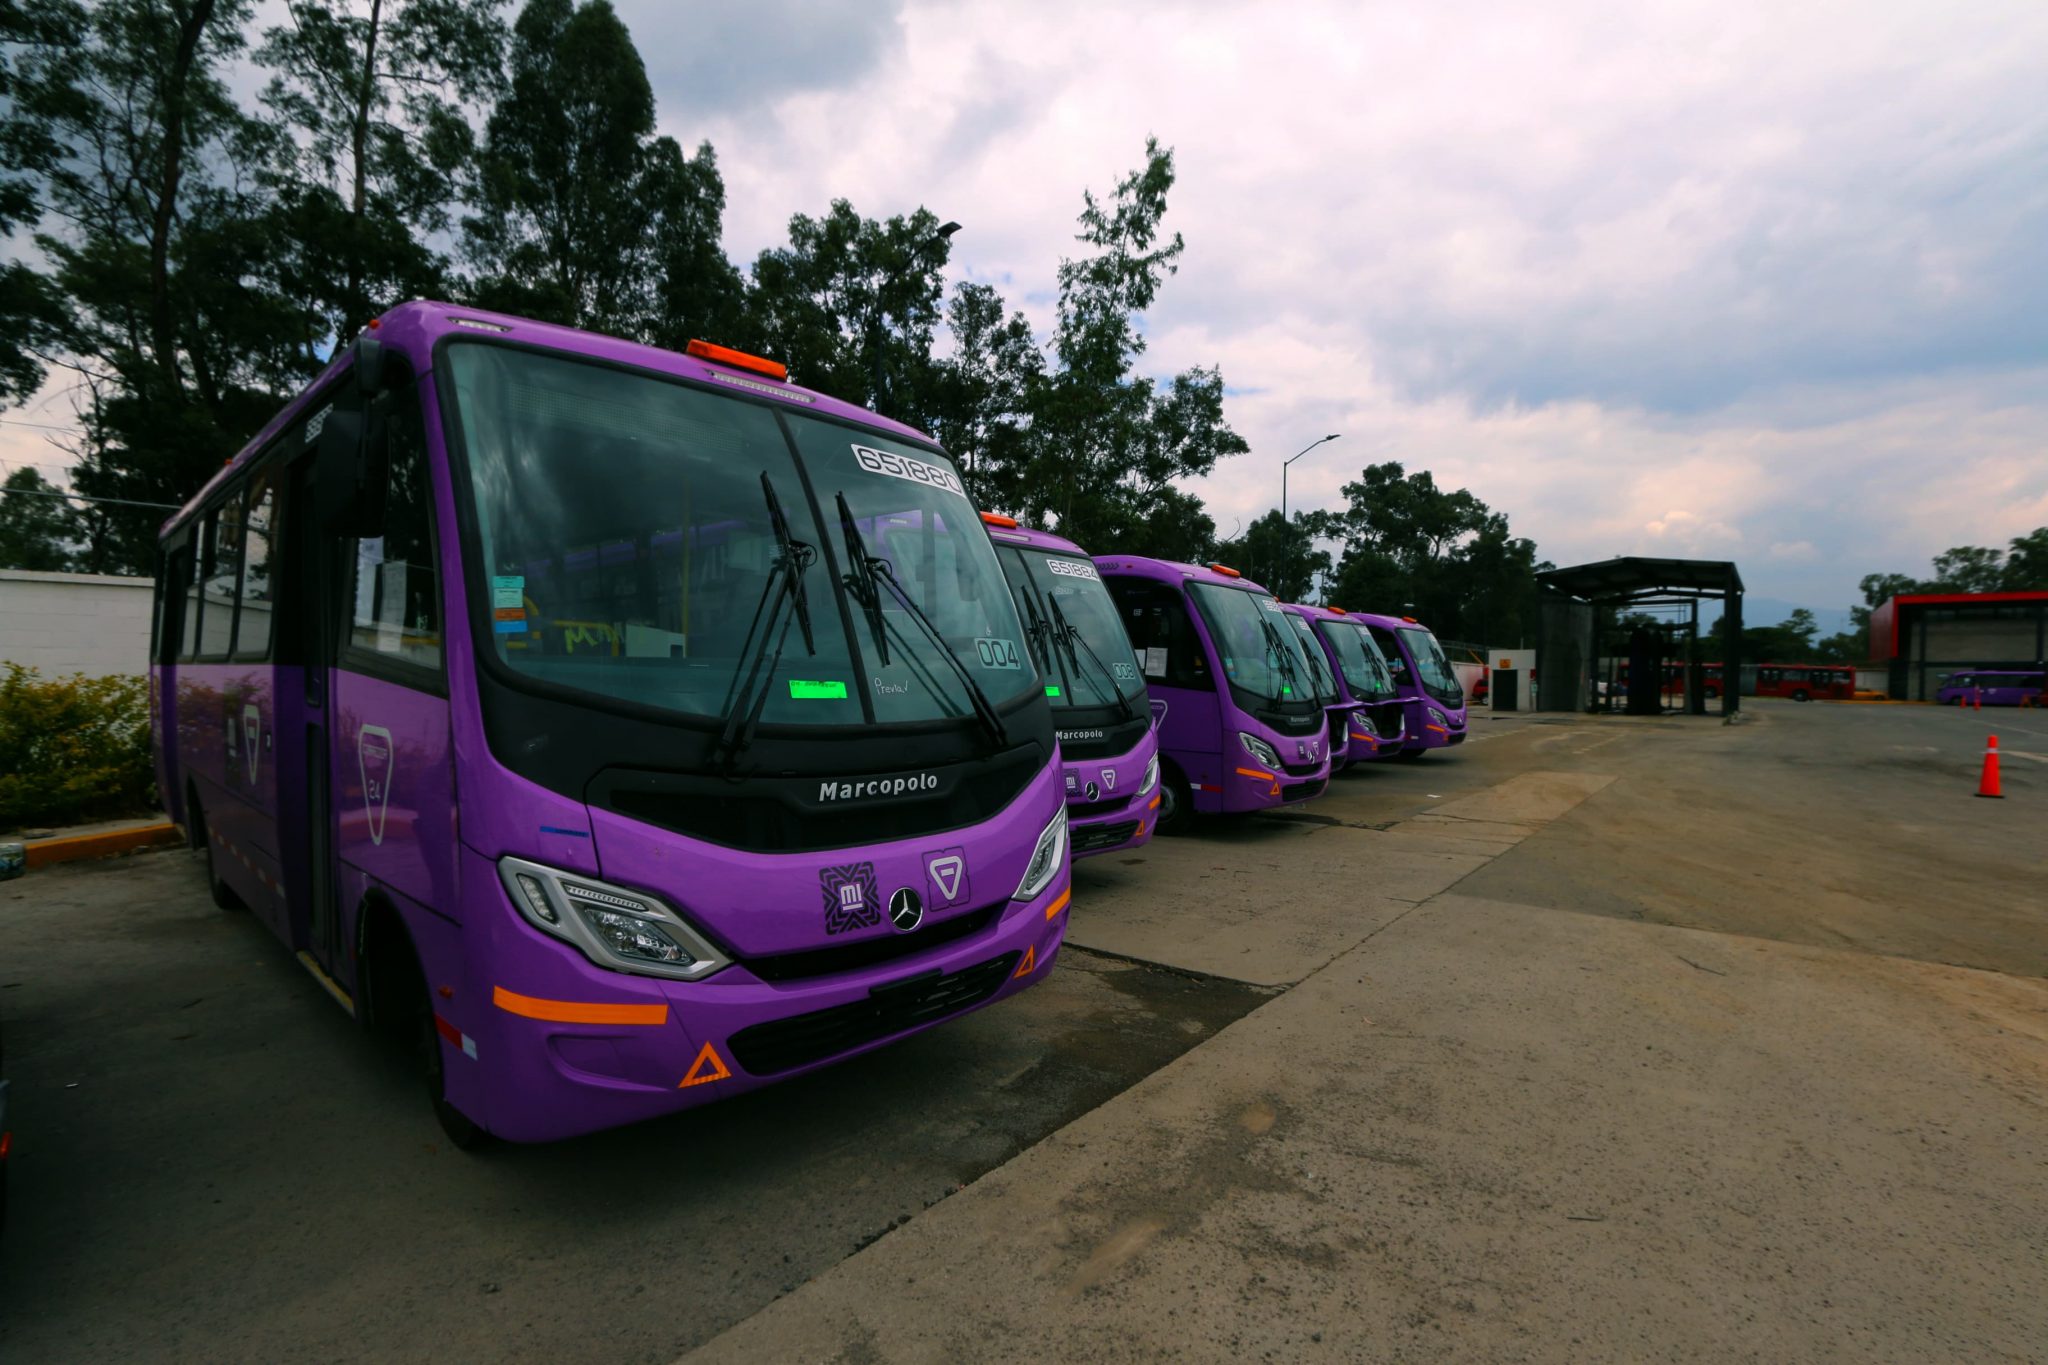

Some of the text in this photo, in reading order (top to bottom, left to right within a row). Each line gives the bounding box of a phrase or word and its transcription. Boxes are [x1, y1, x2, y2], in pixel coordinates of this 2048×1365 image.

[857, 448, 962, 494] 651880
[977, 640, 1019, 667] 004
[1055, 730, 1103, 740] Marcopolo
[819, 773, 937, 801] Marcopolo
